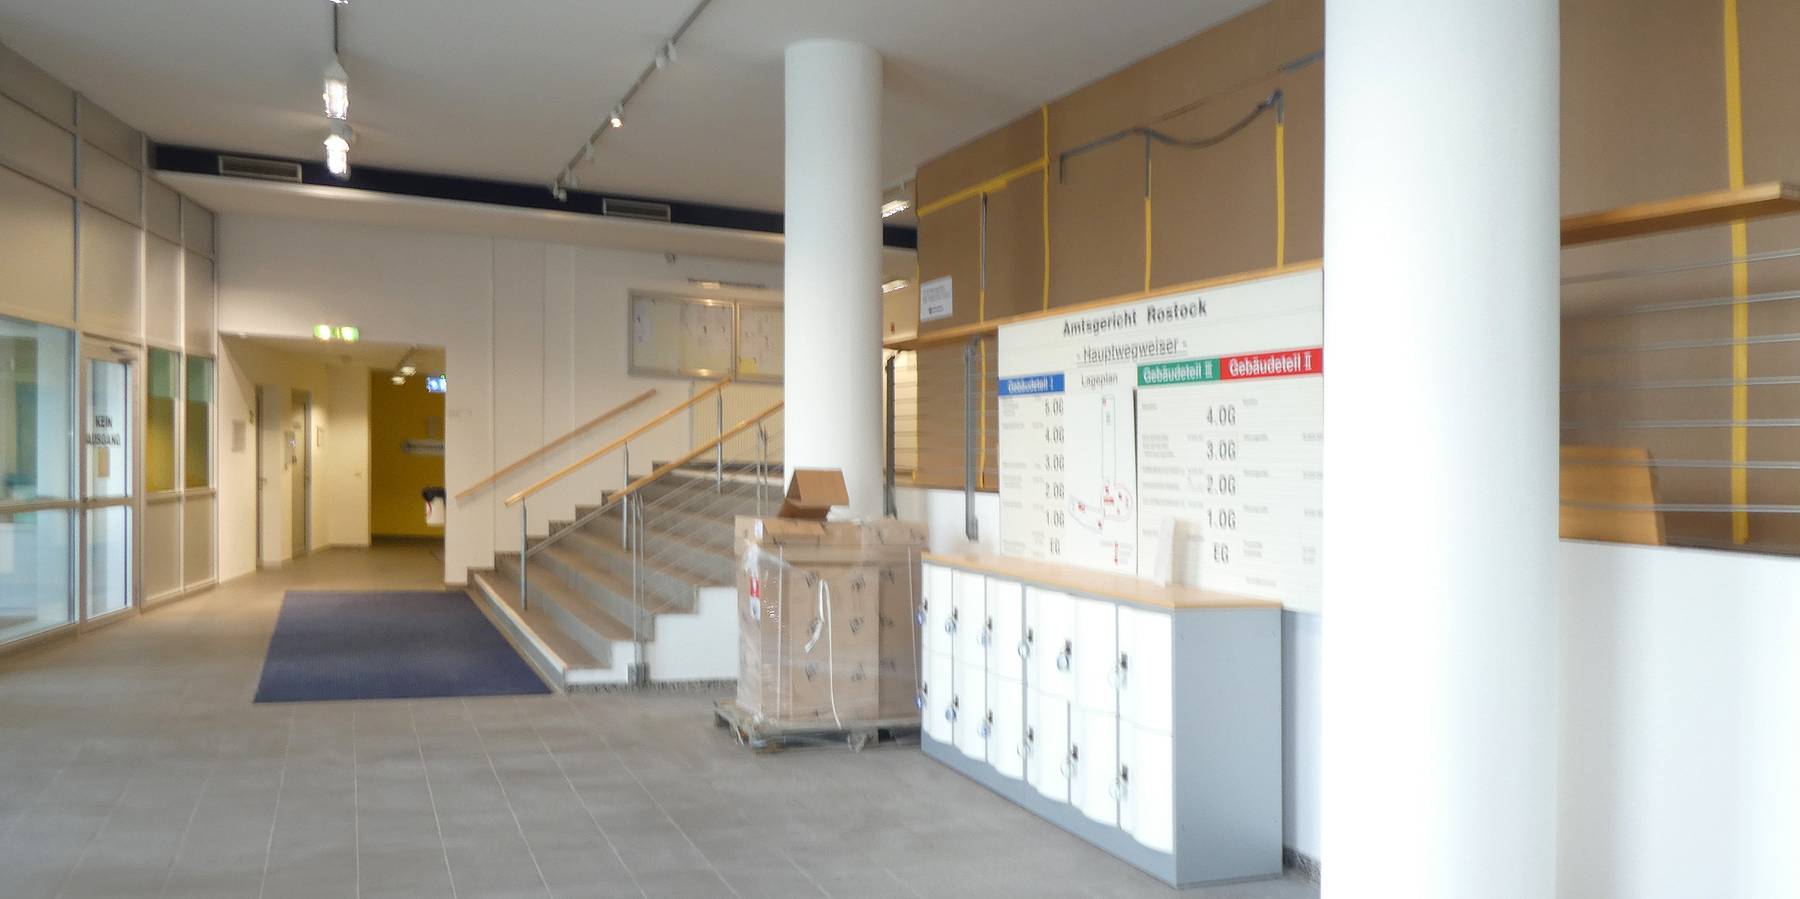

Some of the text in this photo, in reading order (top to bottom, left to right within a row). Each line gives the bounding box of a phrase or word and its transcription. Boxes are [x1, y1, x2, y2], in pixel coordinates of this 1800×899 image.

[1063, 298, 1208, 337] Amtsgericht Rostock
[1083, 338, 1178, 364] Hauptwegweiser
[1143, 361, 1201, 384] Gebäudeteil
[1229, 352, 1301, 377] Gebäudeteil
[1081, 372, 1118, 389] Lageplan
[96, 415, 113, 428] KEIN
